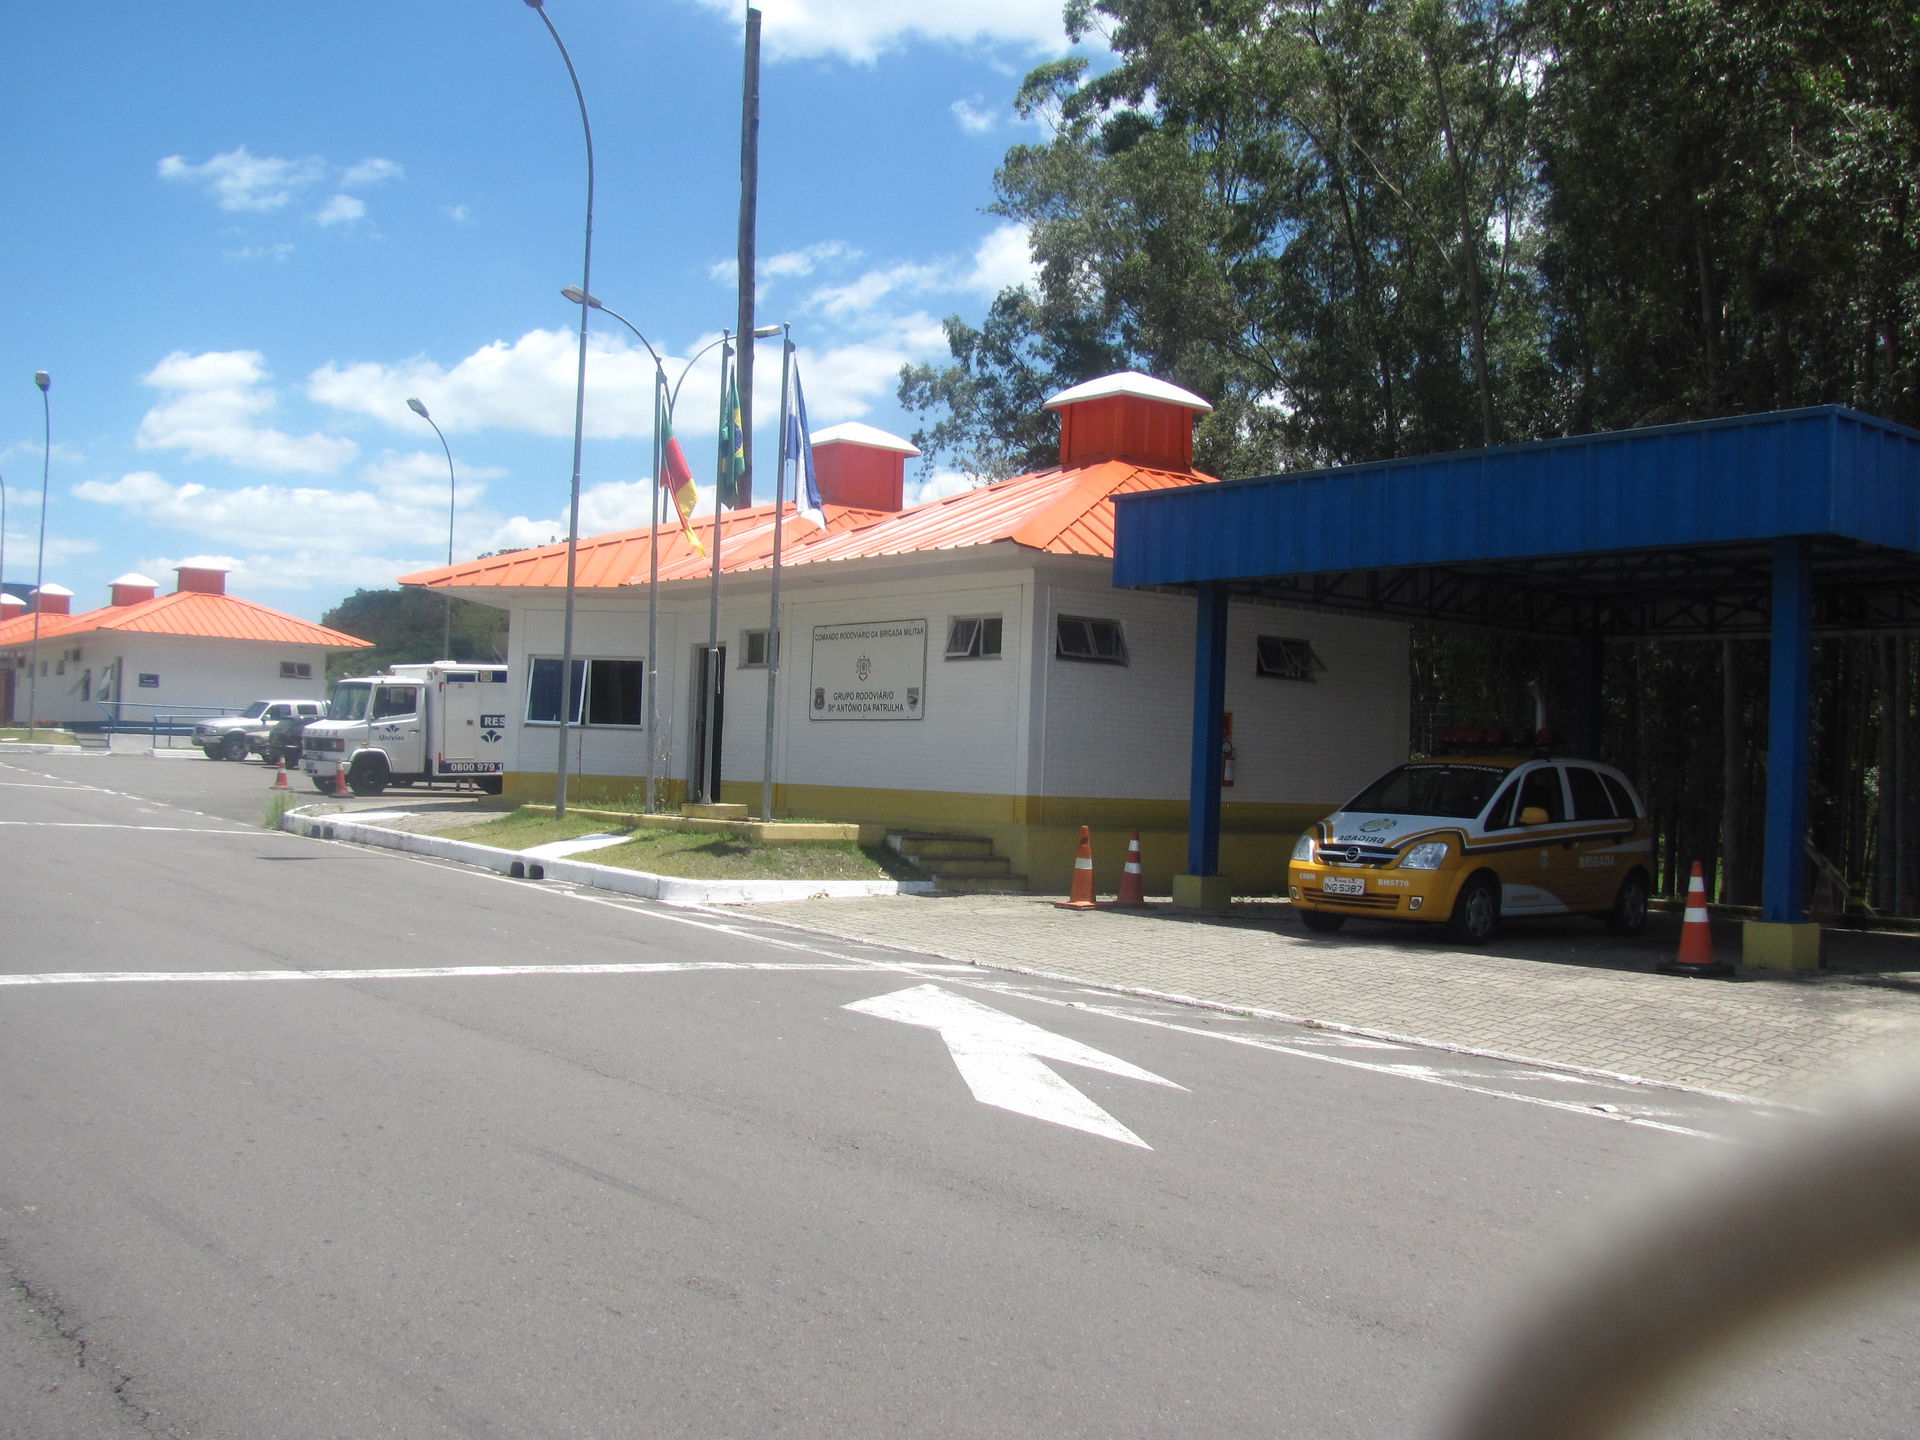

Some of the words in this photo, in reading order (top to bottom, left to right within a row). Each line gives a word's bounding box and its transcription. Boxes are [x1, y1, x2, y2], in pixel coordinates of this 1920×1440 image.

[815, 632, 839, 641] COMANDO
[880, 629, 902, 637] BRIGADA
[904, 627, 924, 635] MILITAR
[834, 692, 855, 701] GRUPO
[863, 703, 871, 712] DA
[872, 703, 904, 712] PATRULHA
[484, 717, 504, 726] RES
[451, 763, 475, 771] 0800
[477, 763, 495, 771] 979
[1578, 856, 1615, 868] BRIGADA
